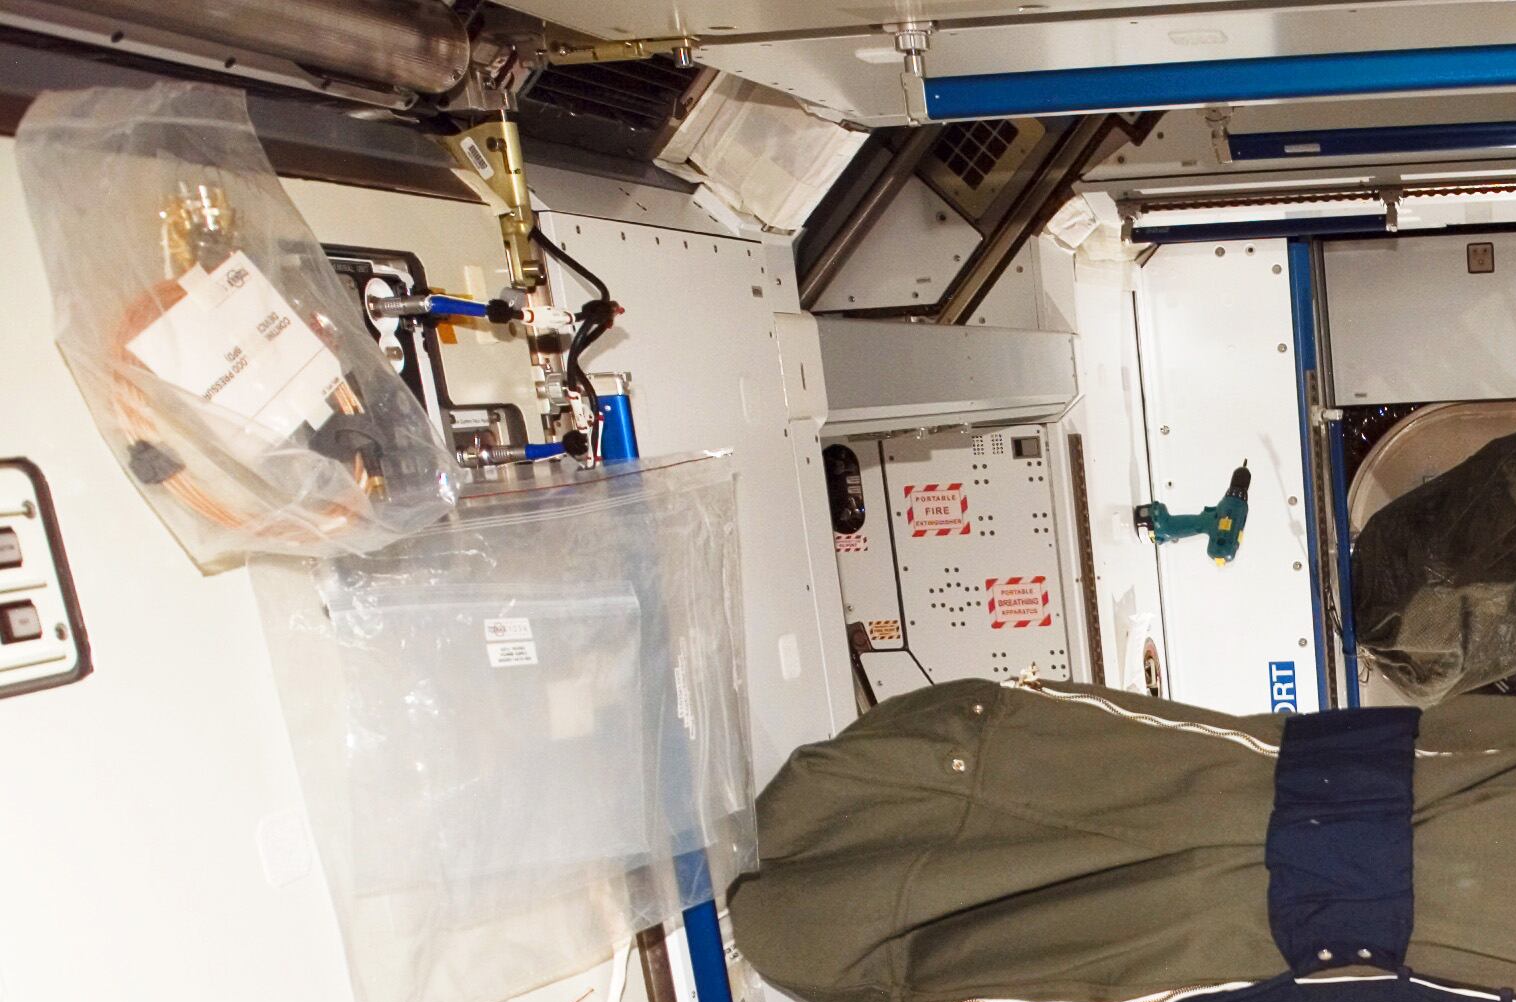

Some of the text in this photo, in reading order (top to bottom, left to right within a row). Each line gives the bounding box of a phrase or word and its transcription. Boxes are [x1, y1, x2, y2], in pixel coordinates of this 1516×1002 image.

[915, 494, 957, 503] PORTABLE
[925, 506, 950, 516] FIRE
[1001, 588, 1034, 596] PORTABLE
[997, 597, 1040, 607] BREATHING
